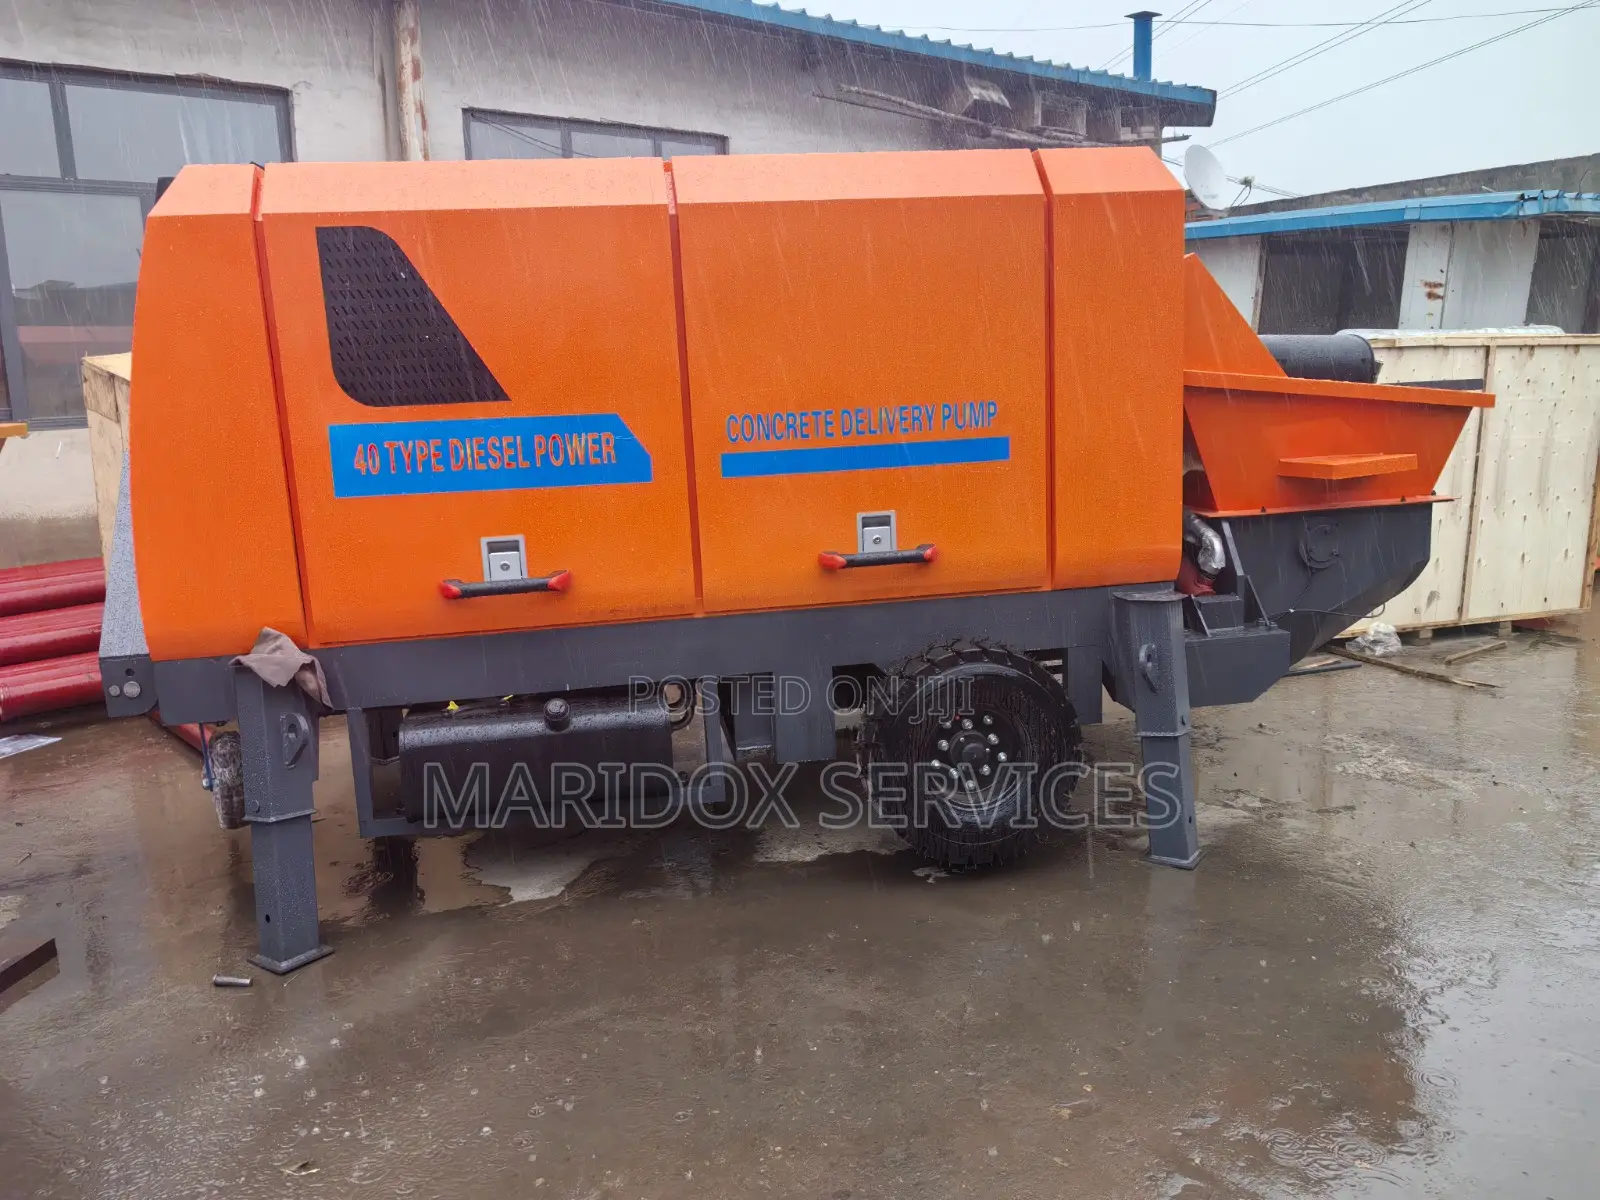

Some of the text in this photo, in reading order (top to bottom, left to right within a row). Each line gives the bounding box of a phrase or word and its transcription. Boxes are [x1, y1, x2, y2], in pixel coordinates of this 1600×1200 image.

[726, 400, 999, 443] CONCRETE DELIVERY PUMP
[354, 431, 617, 475] 40 TYPE DIESEL POWER
